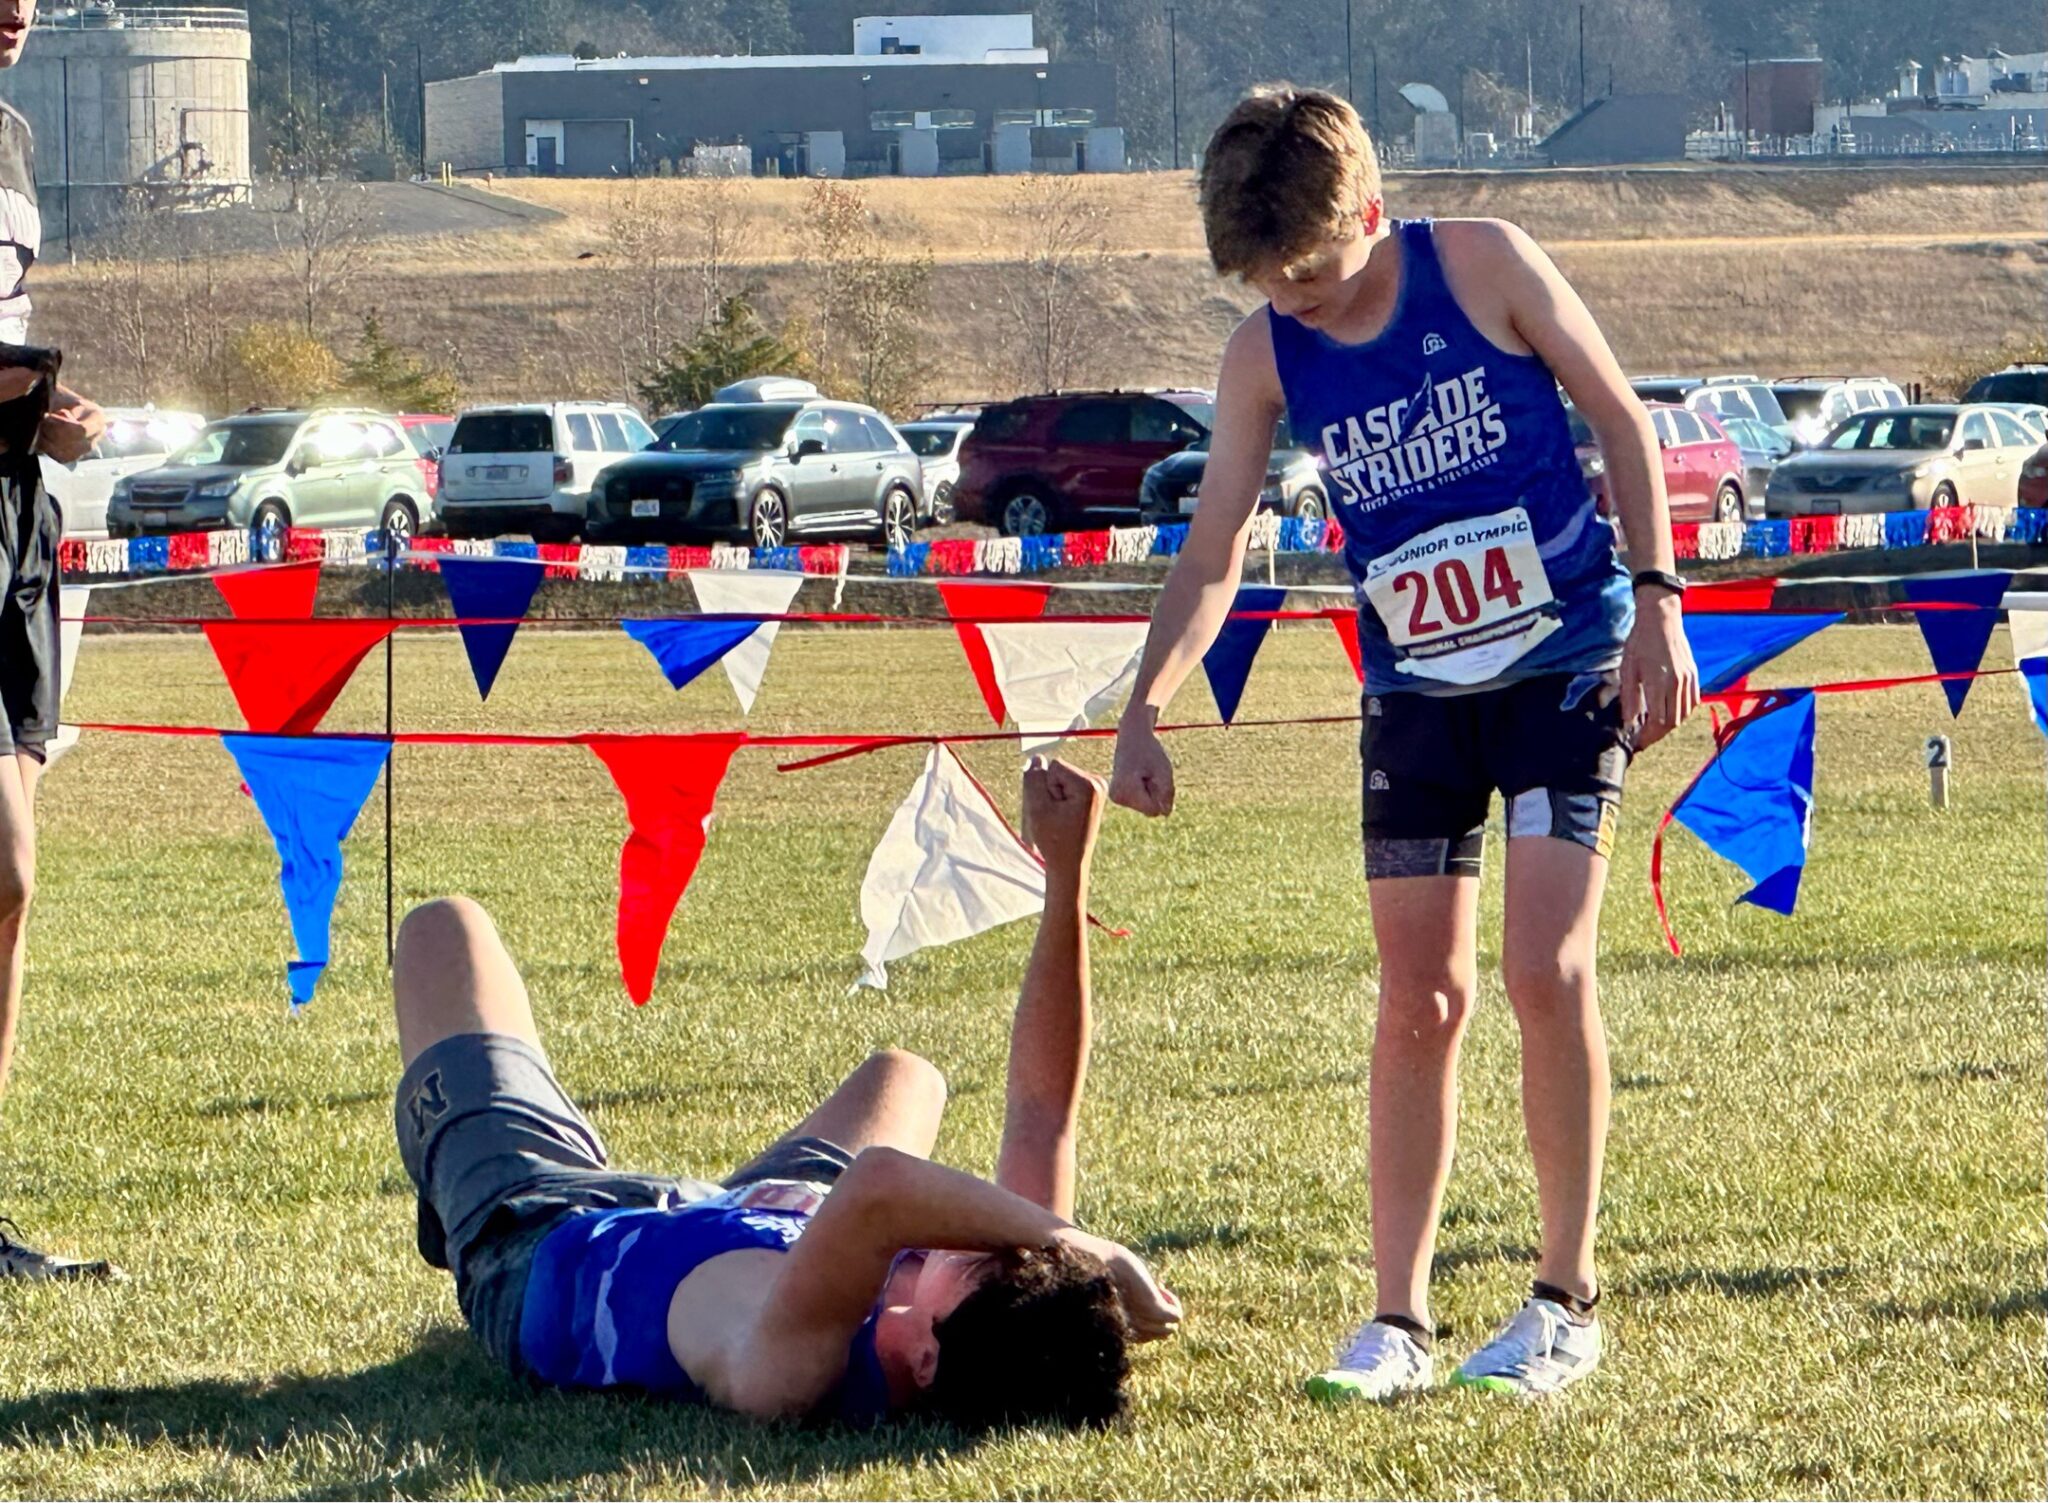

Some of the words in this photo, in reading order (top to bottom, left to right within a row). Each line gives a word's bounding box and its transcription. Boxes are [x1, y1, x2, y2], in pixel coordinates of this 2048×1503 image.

[1322, 366, 1490, 468] CASCADE
[1329, 403, 1507, 505] STRIDERS
[1454, 521, 1528, 546] OLYMPIC
[1393, 547, 1523, 636] 204
[1928, 739, 1947, 768] 2
